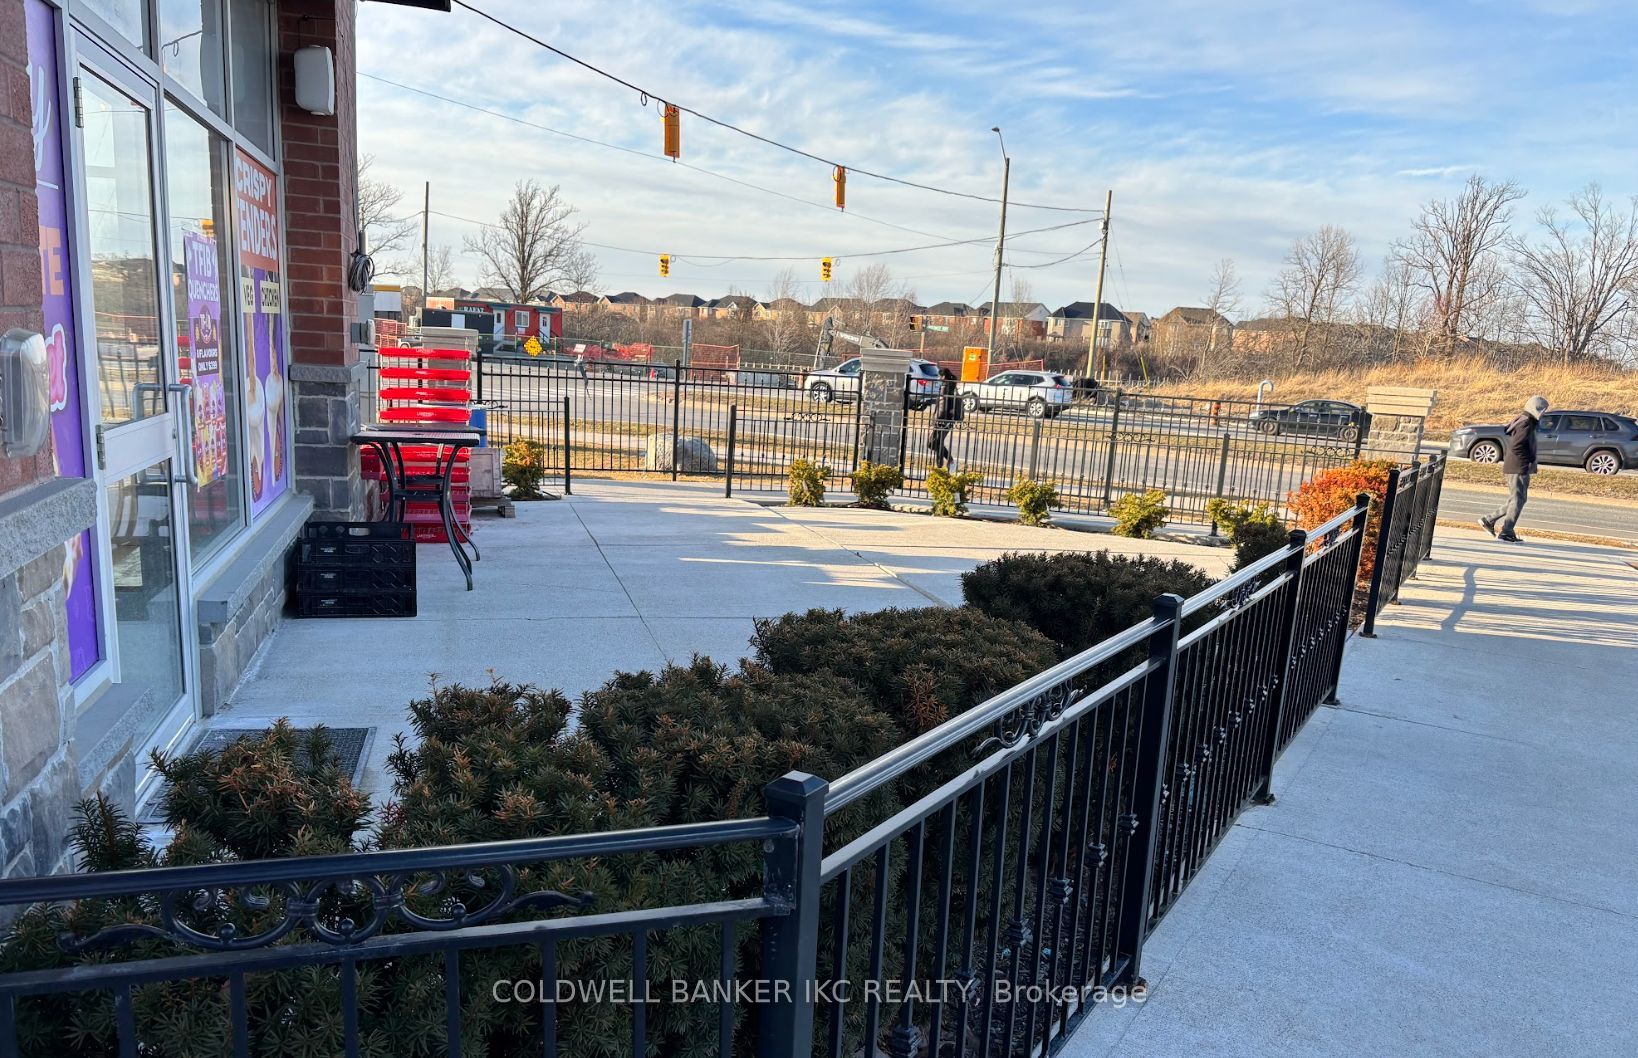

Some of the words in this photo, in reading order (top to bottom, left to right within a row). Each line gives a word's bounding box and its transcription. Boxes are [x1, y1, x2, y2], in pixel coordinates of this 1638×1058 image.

[234, 157, 272, 207] CRISPY
[236, 197, 277, 261] ENDERS
[192, 240, 212, 278] TFIB
[188, 279, 219, 302] QUENCHERS
[839, 332, 859, 342] VOLVO
